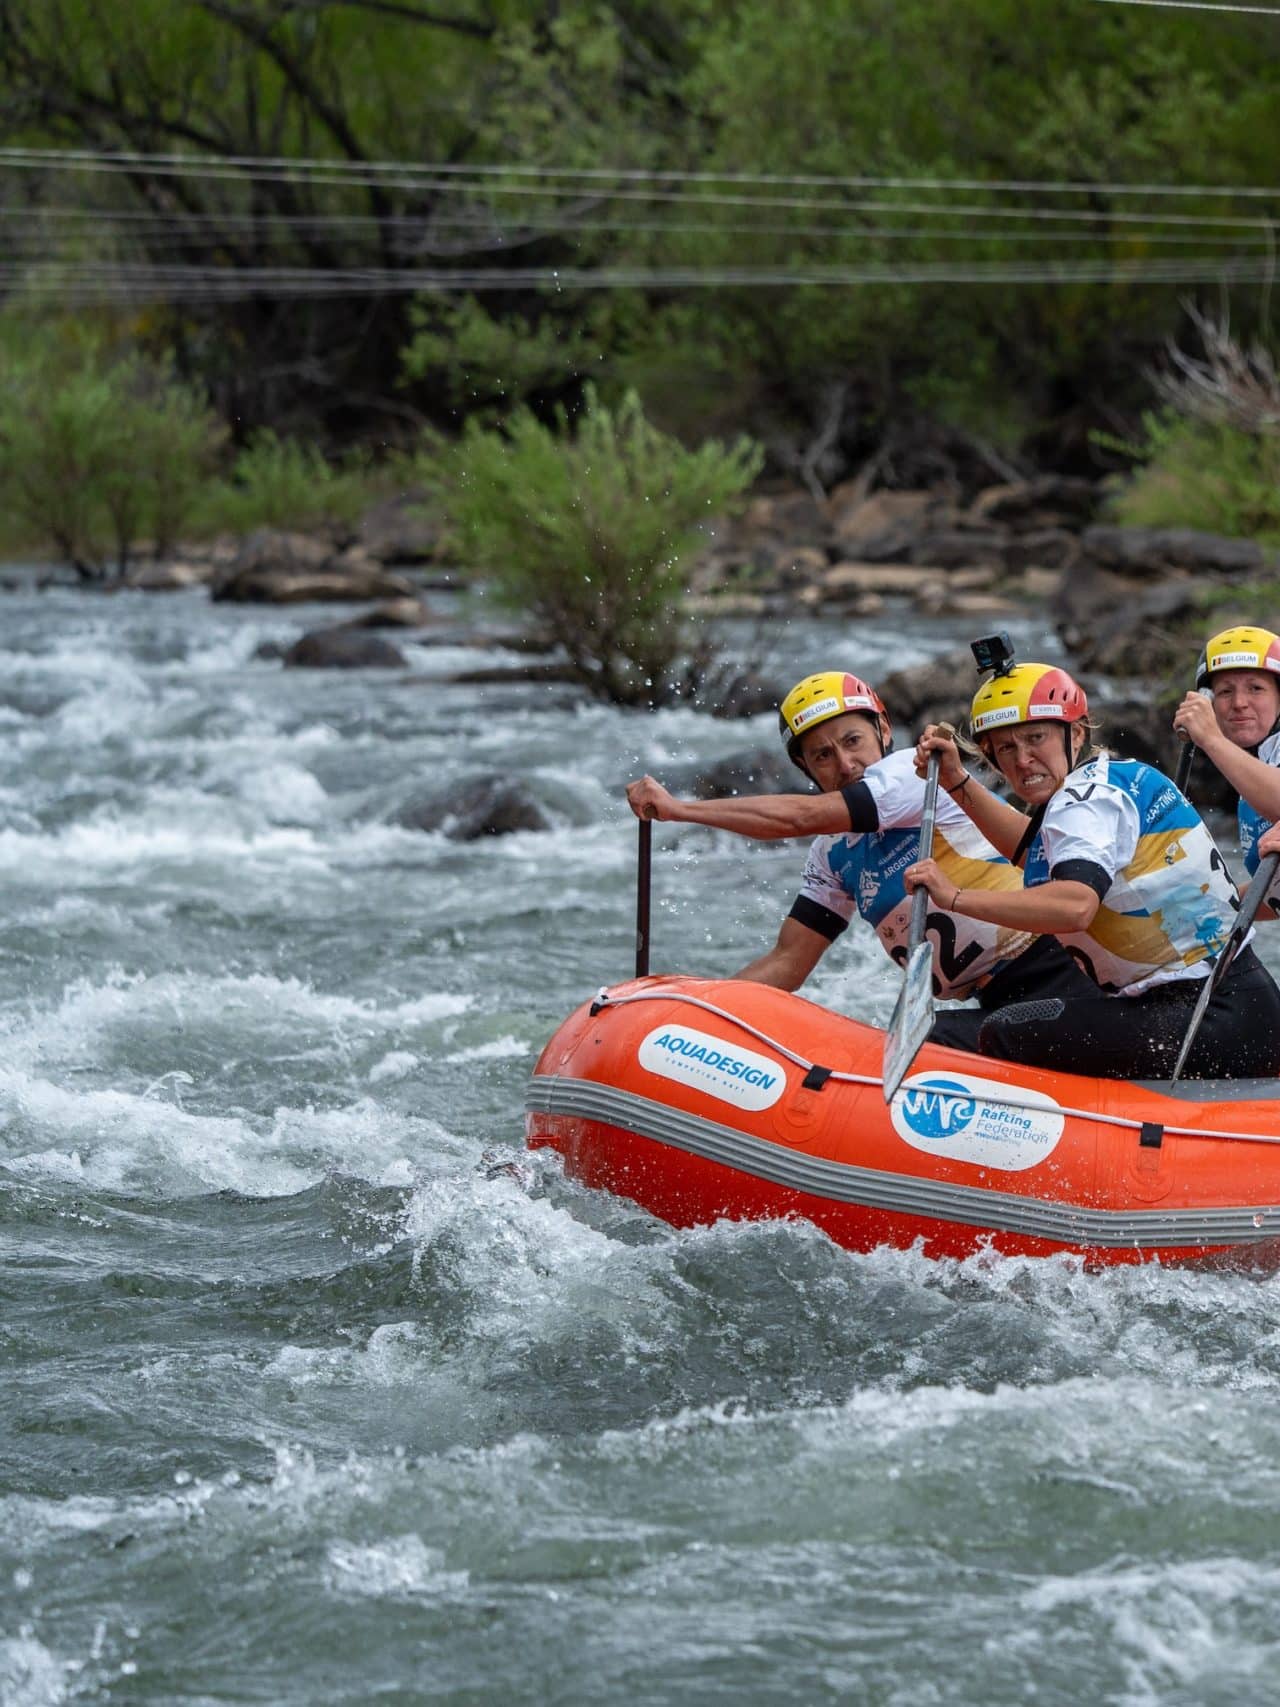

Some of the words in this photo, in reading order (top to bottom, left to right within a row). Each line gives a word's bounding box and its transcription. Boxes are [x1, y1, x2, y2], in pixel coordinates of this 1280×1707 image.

[1221, 655, 1257, 665] BELGIUM
[803, 700, 837, 720] BELGIUM
[983, 710, 1017, 724] BELGIUM
[653, 1033, 777, 1090] AQUADESIGN
[980, 1107, 1032, 1130] Rafting
[976, 1119, 1049, 1145] Federation
